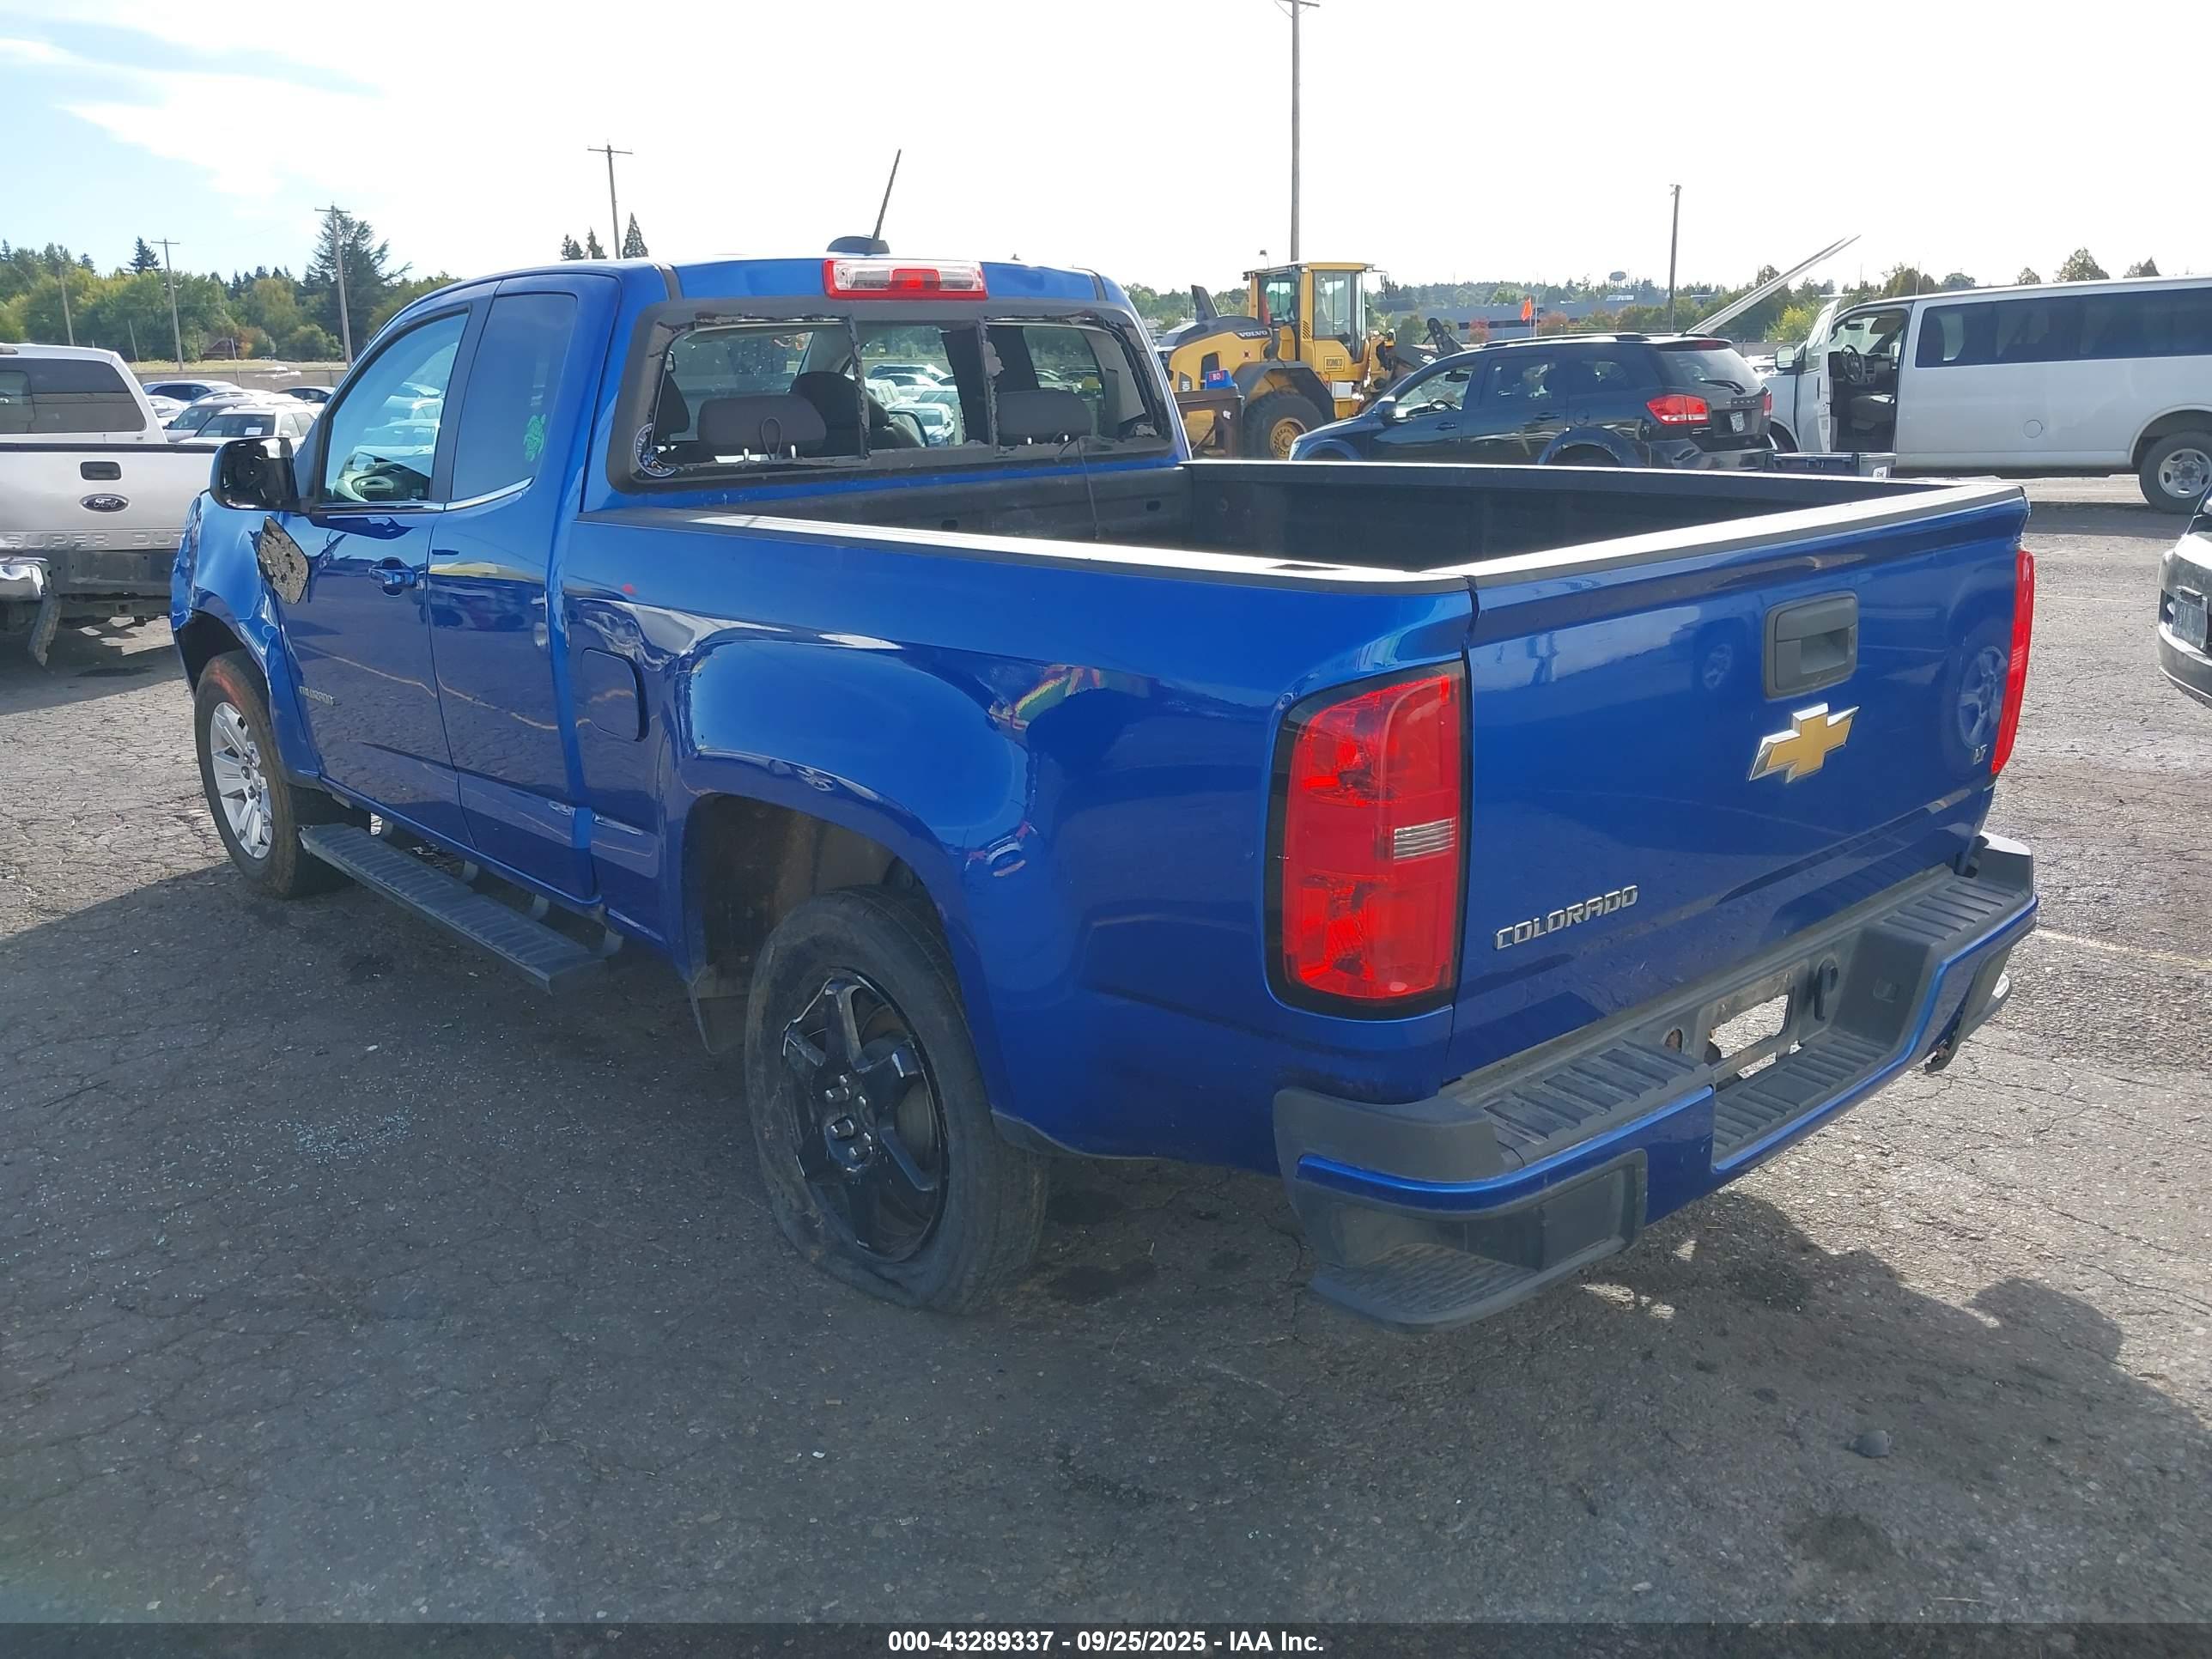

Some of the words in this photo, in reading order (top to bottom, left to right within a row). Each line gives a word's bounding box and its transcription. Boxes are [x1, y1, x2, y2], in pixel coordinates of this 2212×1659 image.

[93, 497, 118, 508] Ford
[3, 533, 111, 549] SUPER
[1495, 884, 1638, 951] COLORADO
